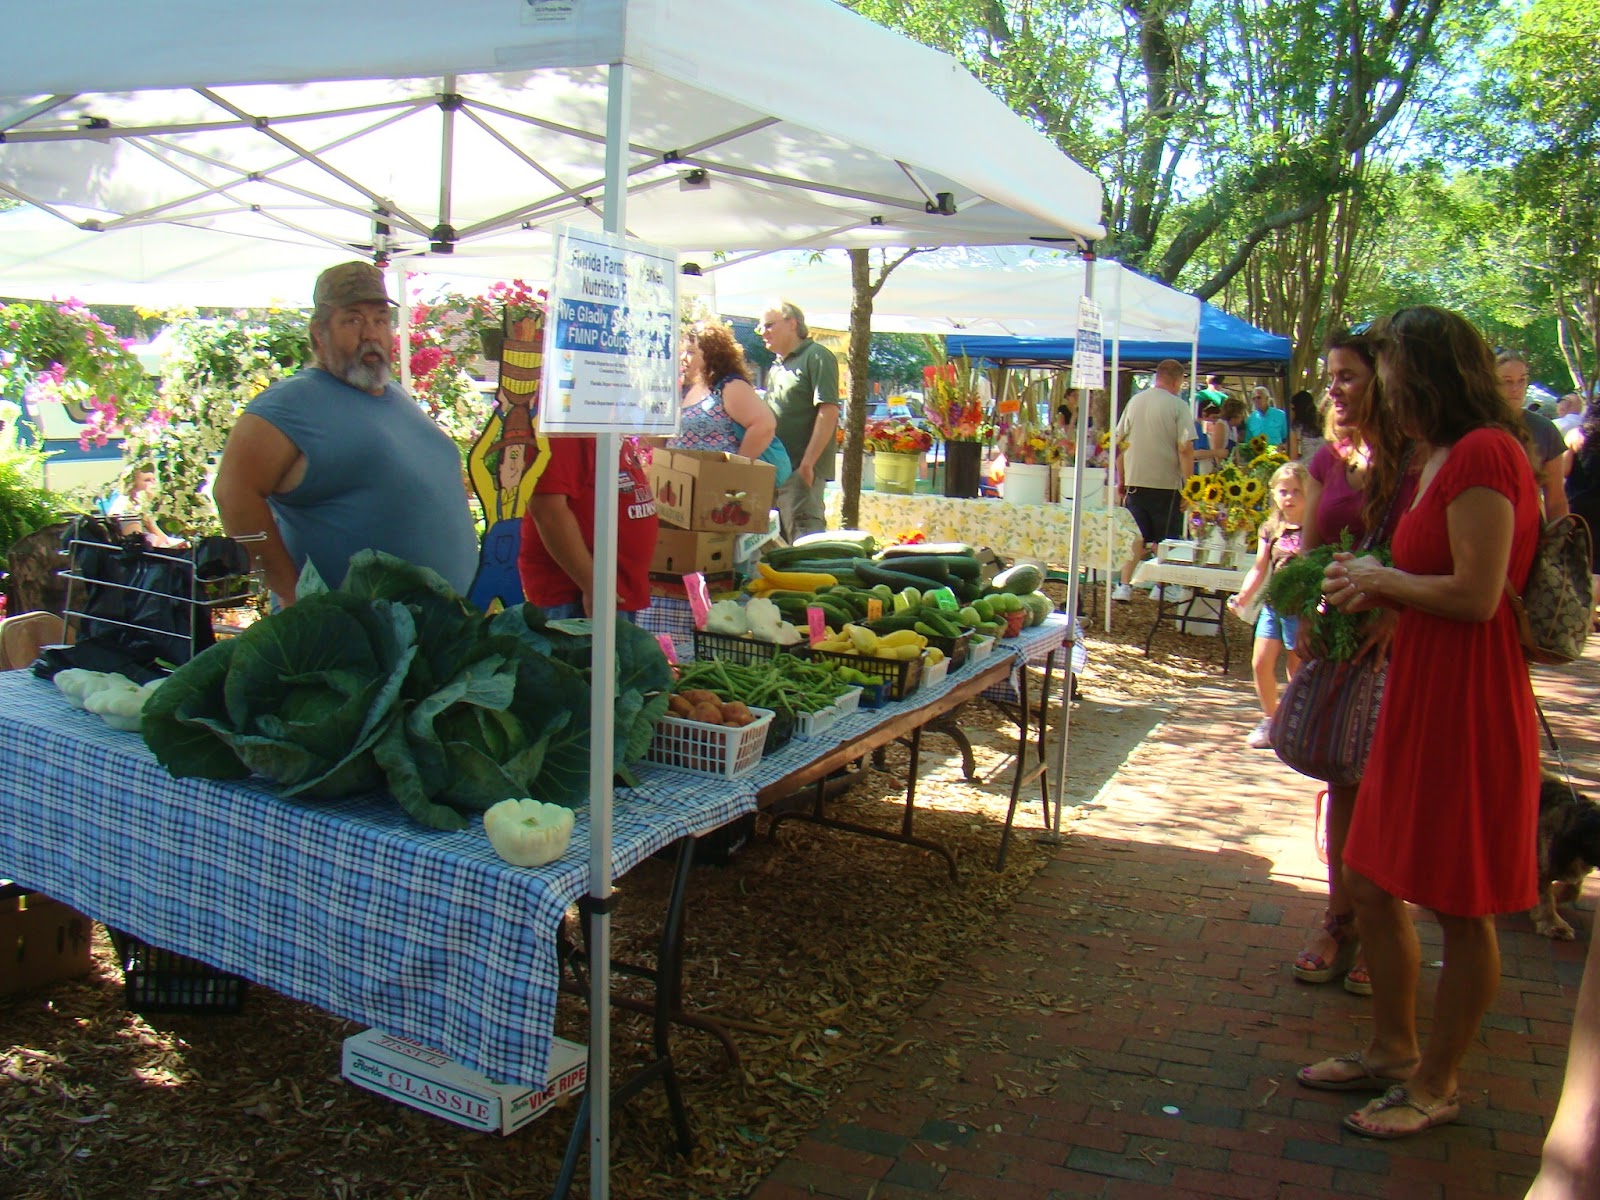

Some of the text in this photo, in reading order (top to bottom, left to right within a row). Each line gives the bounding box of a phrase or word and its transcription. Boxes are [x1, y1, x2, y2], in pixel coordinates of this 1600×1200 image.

[571, 249, 601, 272] Florida
[582, 276, 620, 300] Nutrition
[559, 302, 576, 321] We
[577, 304, 609, 329] Gladly
[568, 326, 599, 346] FMNP
[559, 1067, 586, 1093] RIPE
[387, 1072, 490, 1120] CLASSIE
